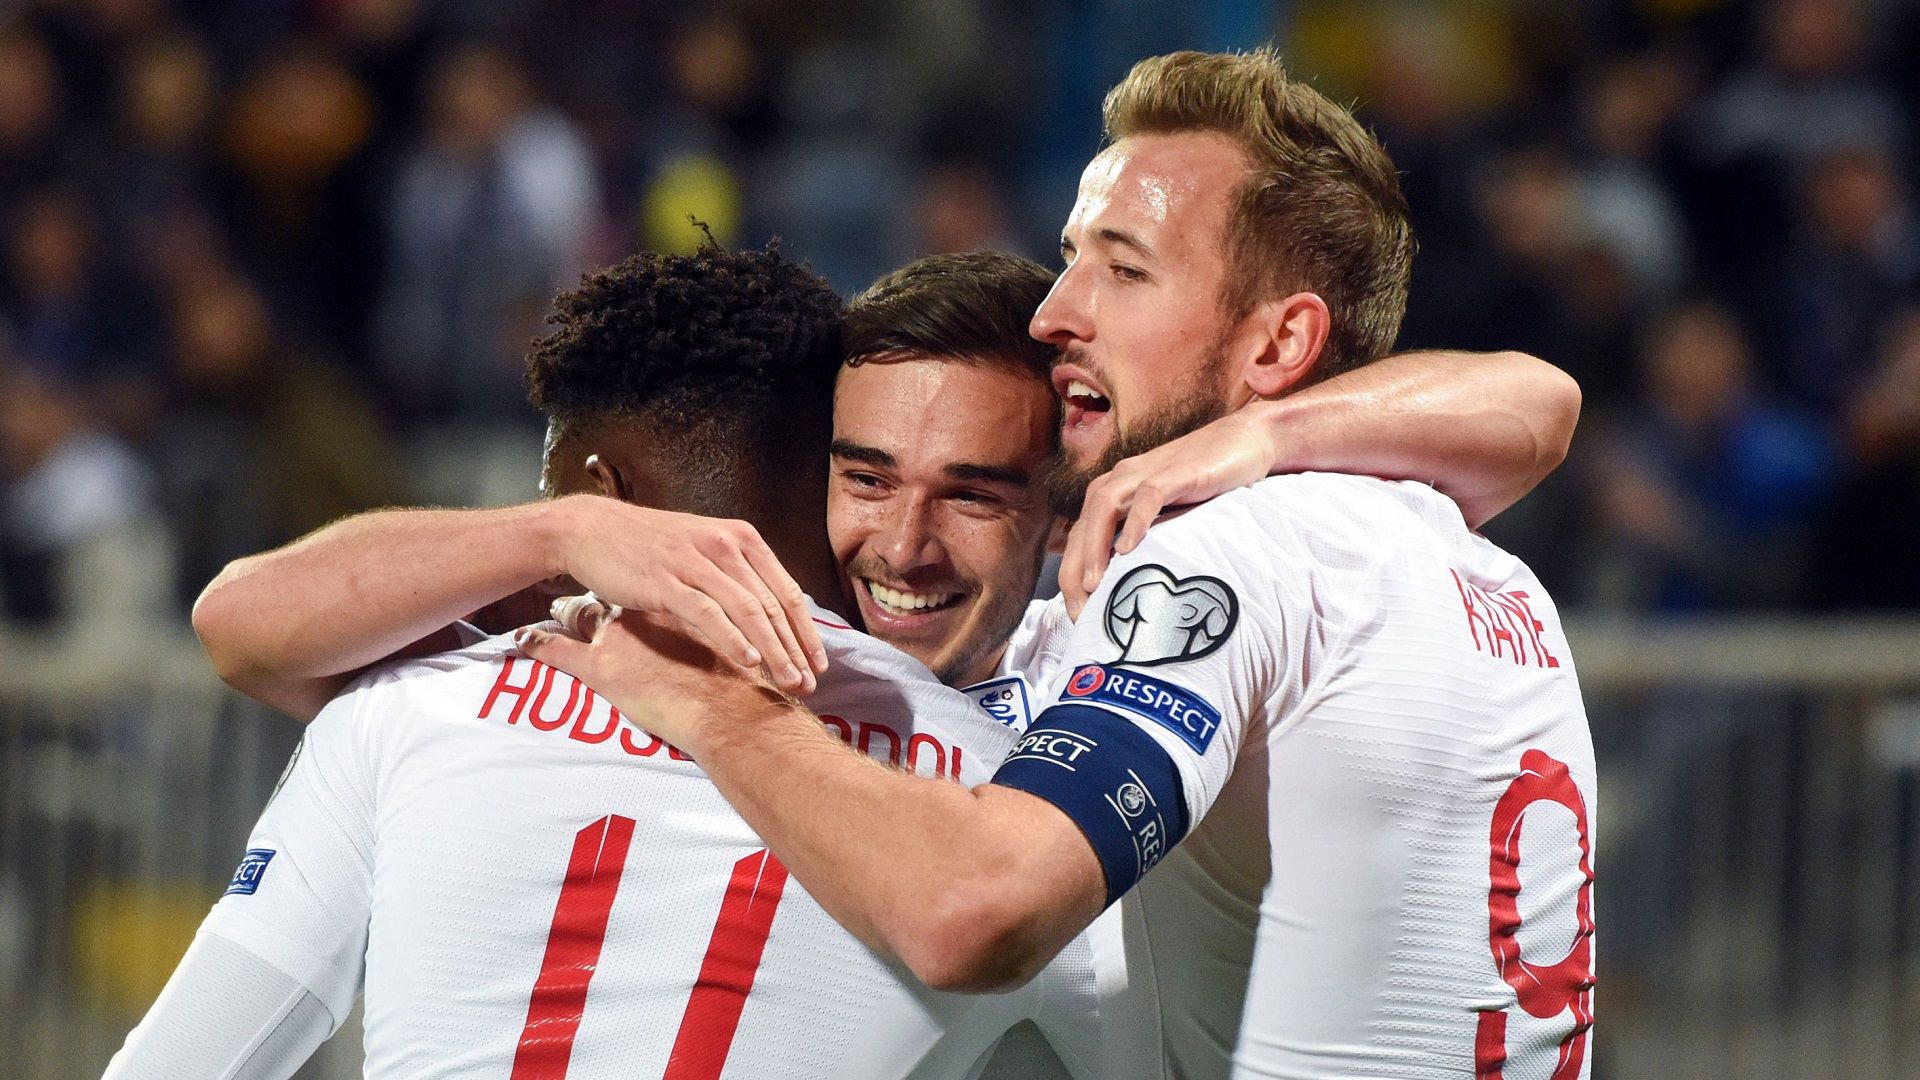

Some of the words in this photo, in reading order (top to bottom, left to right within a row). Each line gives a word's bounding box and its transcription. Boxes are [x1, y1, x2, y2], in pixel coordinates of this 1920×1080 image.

[1104, 674, 1216, 740] RESPECT
[1449, 567, 1560, 668] KANE
[510, 813, 790, 1080] 11
[1474, 748, 1597, 1080] 9
